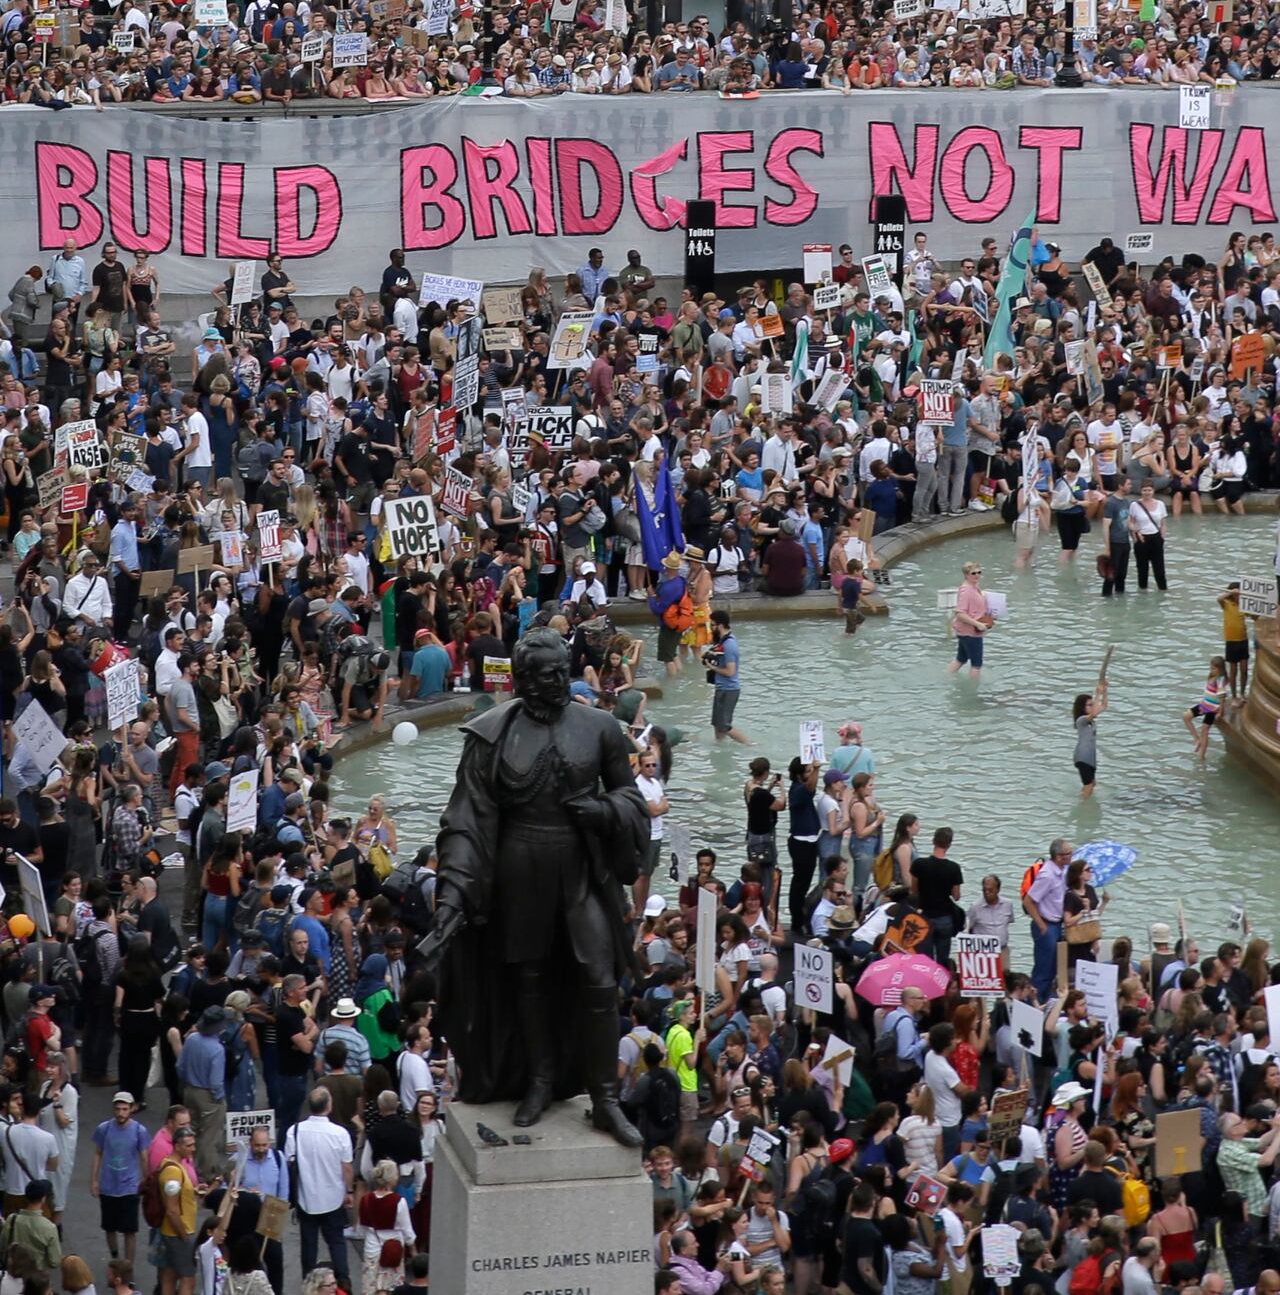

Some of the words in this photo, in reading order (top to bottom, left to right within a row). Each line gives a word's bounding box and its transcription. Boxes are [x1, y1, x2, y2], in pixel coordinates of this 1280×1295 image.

[429, 8, 450, 20] AGAIN
[896, 5, 918, 15] TRUMP
[335, 36, 364, 46] MUSLIMS
[302, 46, 322, 57] TRUMP
[335, 44, 361, 53] WELCOME
[333, 55, 353, 65] TRUMP
[1181, 87, 1209, 98] TRUMP
[1188, 101, 1200, 111] IS
[1181, 114, 1209, 128] WEAK
[35, 139, 342, 259] BUILD
[399, 127, 824, 251] BRIDGES
[867, 121, 1083, 225] NOT
[688, 227, 715, 237] Toilets
[877, 222, 904, 232] Toilets
[424, 276, 444, 285] BORIS
[466, 281, 481, 292] YOU
[867, 273, 888, 285] FREE
[816, 287, 838, 298] #DUMP
[816, 294, 839, 305] TRUMP
[639, 340, 658, 352] LOVE
[921, 380, 952, 394] TRUMP
[923, 394, 952, 413] NOT
[923, 411, 953, 420] WELCOME
[515, 416, 571, 436] FUCK
[70, 429, 97, 444] TRUMP
[72, 445, 102, 468] ARSE
[110, 458, 137, 473] GREAT
[445, 466, 472, 490] TRUMP
[444, 484, 467, 505] NOT
[257, 511, 280, 526] TRUMP
[395, 500, 429, 526] NO
[259, 524, 280, 547] NOT
[391, 523, 438, 555] HOPE
[1242, 579, 1275, 595] DUMP
[1240, 596, 1278, 614] TRUMP
[799, 720, 822, 732] TRUMP
[803, 743, 825, 760] FART
[958, 936, 1000, 954] TRUMP
[802, 951, 824, 972] NO
[960, 953, 999, 979] NOT
[962, 978, 1003, 990] WELCOME
[229, 1114, 272, 1127] #DUMP
[472, 1255, 539, 1272] CHARLES
[543, 1253, 591, 1270] JAMES
[595, 1248, 651, 1267] NAPIER
